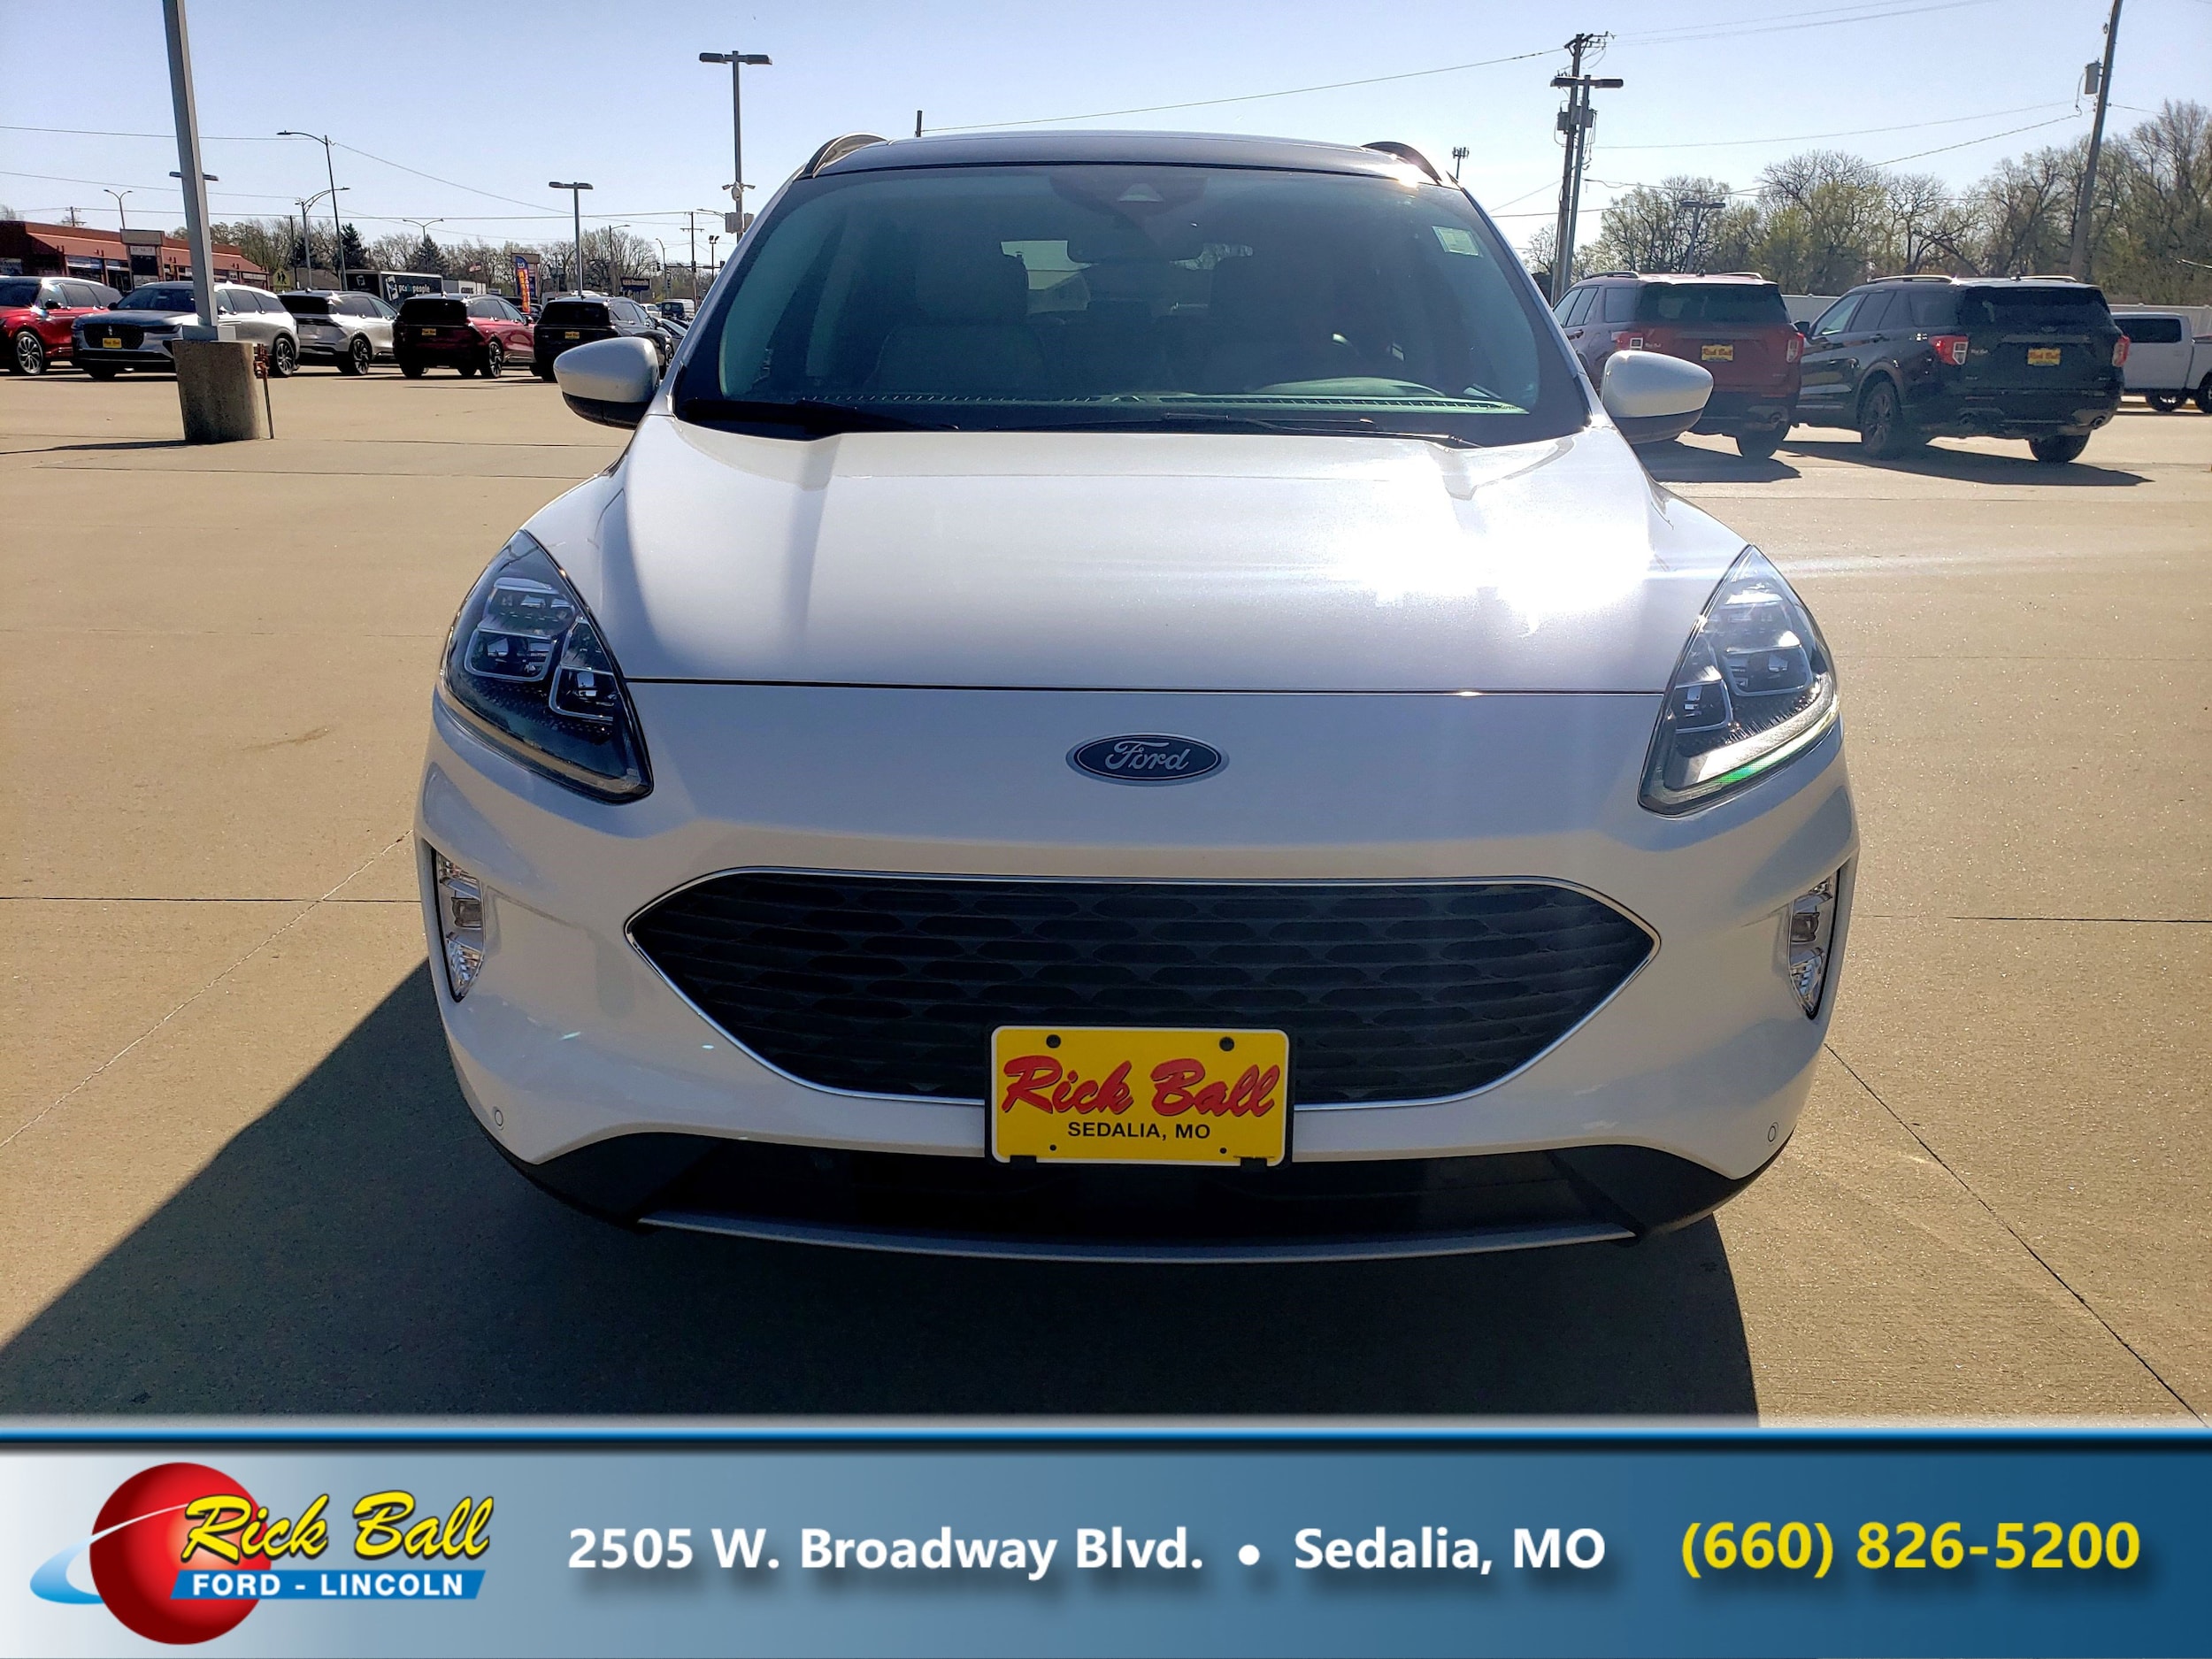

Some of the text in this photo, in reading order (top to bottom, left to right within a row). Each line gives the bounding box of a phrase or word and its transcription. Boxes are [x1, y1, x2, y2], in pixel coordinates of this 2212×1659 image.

[1104, 740, 1192, 771] Ford
[1002, 1055, 1280, 1117] Rick Ball
[1067, 1121, 1211, 1141] SEDALIA, MO
